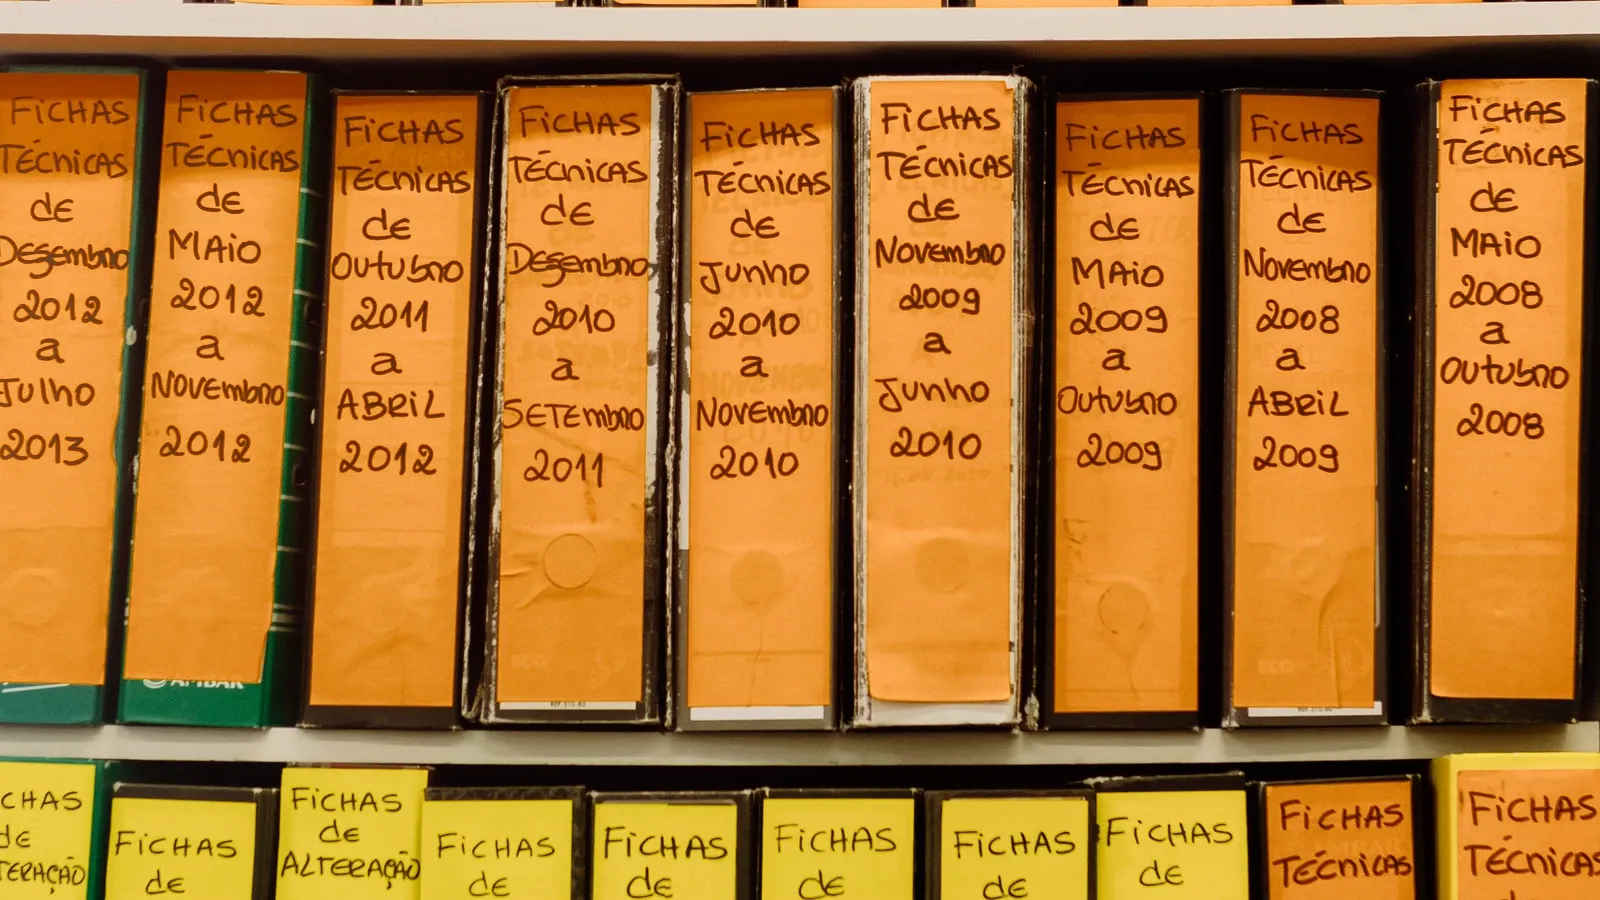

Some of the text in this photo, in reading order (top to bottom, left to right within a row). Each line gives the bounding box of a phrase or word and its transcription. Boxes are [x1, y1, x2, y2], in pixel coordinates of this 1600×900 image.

[30, 192, 74, 223] de
[196, 183, 244, 214] de
[540, 193, 594, 226] de
[908, 192, 960, 223] de
[1470, 182, 1519, 213] de
[362, 208, 411, 241] de
[730, 208, 780, 239] de
[1090, 212, 1140, 241] de
[1277, 203, 1327, 234] de
[331, 250, 464, 283] Outubro
[699, 260, 810, 295] Junho
[13, 289, 103, 325] 2012
[170, 278, 265, 317] 2012
[899, 283, 980, 315] 2009
[1449, 274, 1543, 309] 2008
[351, 296, 429, 332] 2011
[532, 300, 615, 336] 2010
[709, 306, 800, 340] 2010
[1070, 302, 1168, 335] 2009
[1256, 299, 1339, 334] 2008
[196, 335, 225, 361] a
[923, 332, 952, 355] a
[1479, 321, 1510, 345] a
[36, 338, 65, 364] a
[371, 352, 403, 375] a
[740, 356, 769, 378] a
[1102, 349, 1131, 371] a
[1276, 348, 1306, 371] a
[551, 358, 580, 381] a
[1440, 354, 1570, 389] Outubro
[0, 378, 95, 407] Julho
[874, 377, 990, 413] Junho
[1057, 385, 1177, 416] Outubro
[1457, 403, 1545, 440] 2008
[0, 429, 89, 466] 2013
[159, 425, 251, 463] 2012
[339, 440, 437, 475] 2012
[890, 426, 982, 460] 2010
[1077, 433, 1162, 471] 2009
[1253, 436, 1339, 473] 2009
[524, 449, 603, 488] 2011
[710, 445, 799, 480] 2010
[1, 790, 82, 811] CHAS
[319, 819, 360, 843] de
[0, 856, 86, 895] ERAÇÃO
[145, 876, 185, 895] de
[281, 850, 421, 892] ALTERAÇÃO
[469, 874, 510, 897] de
[626, 867, 673, 899] de
[798, 869, 844, 900] de
[1139, 860, 1184, 887] de
[983, 875, 1028, 900] de
